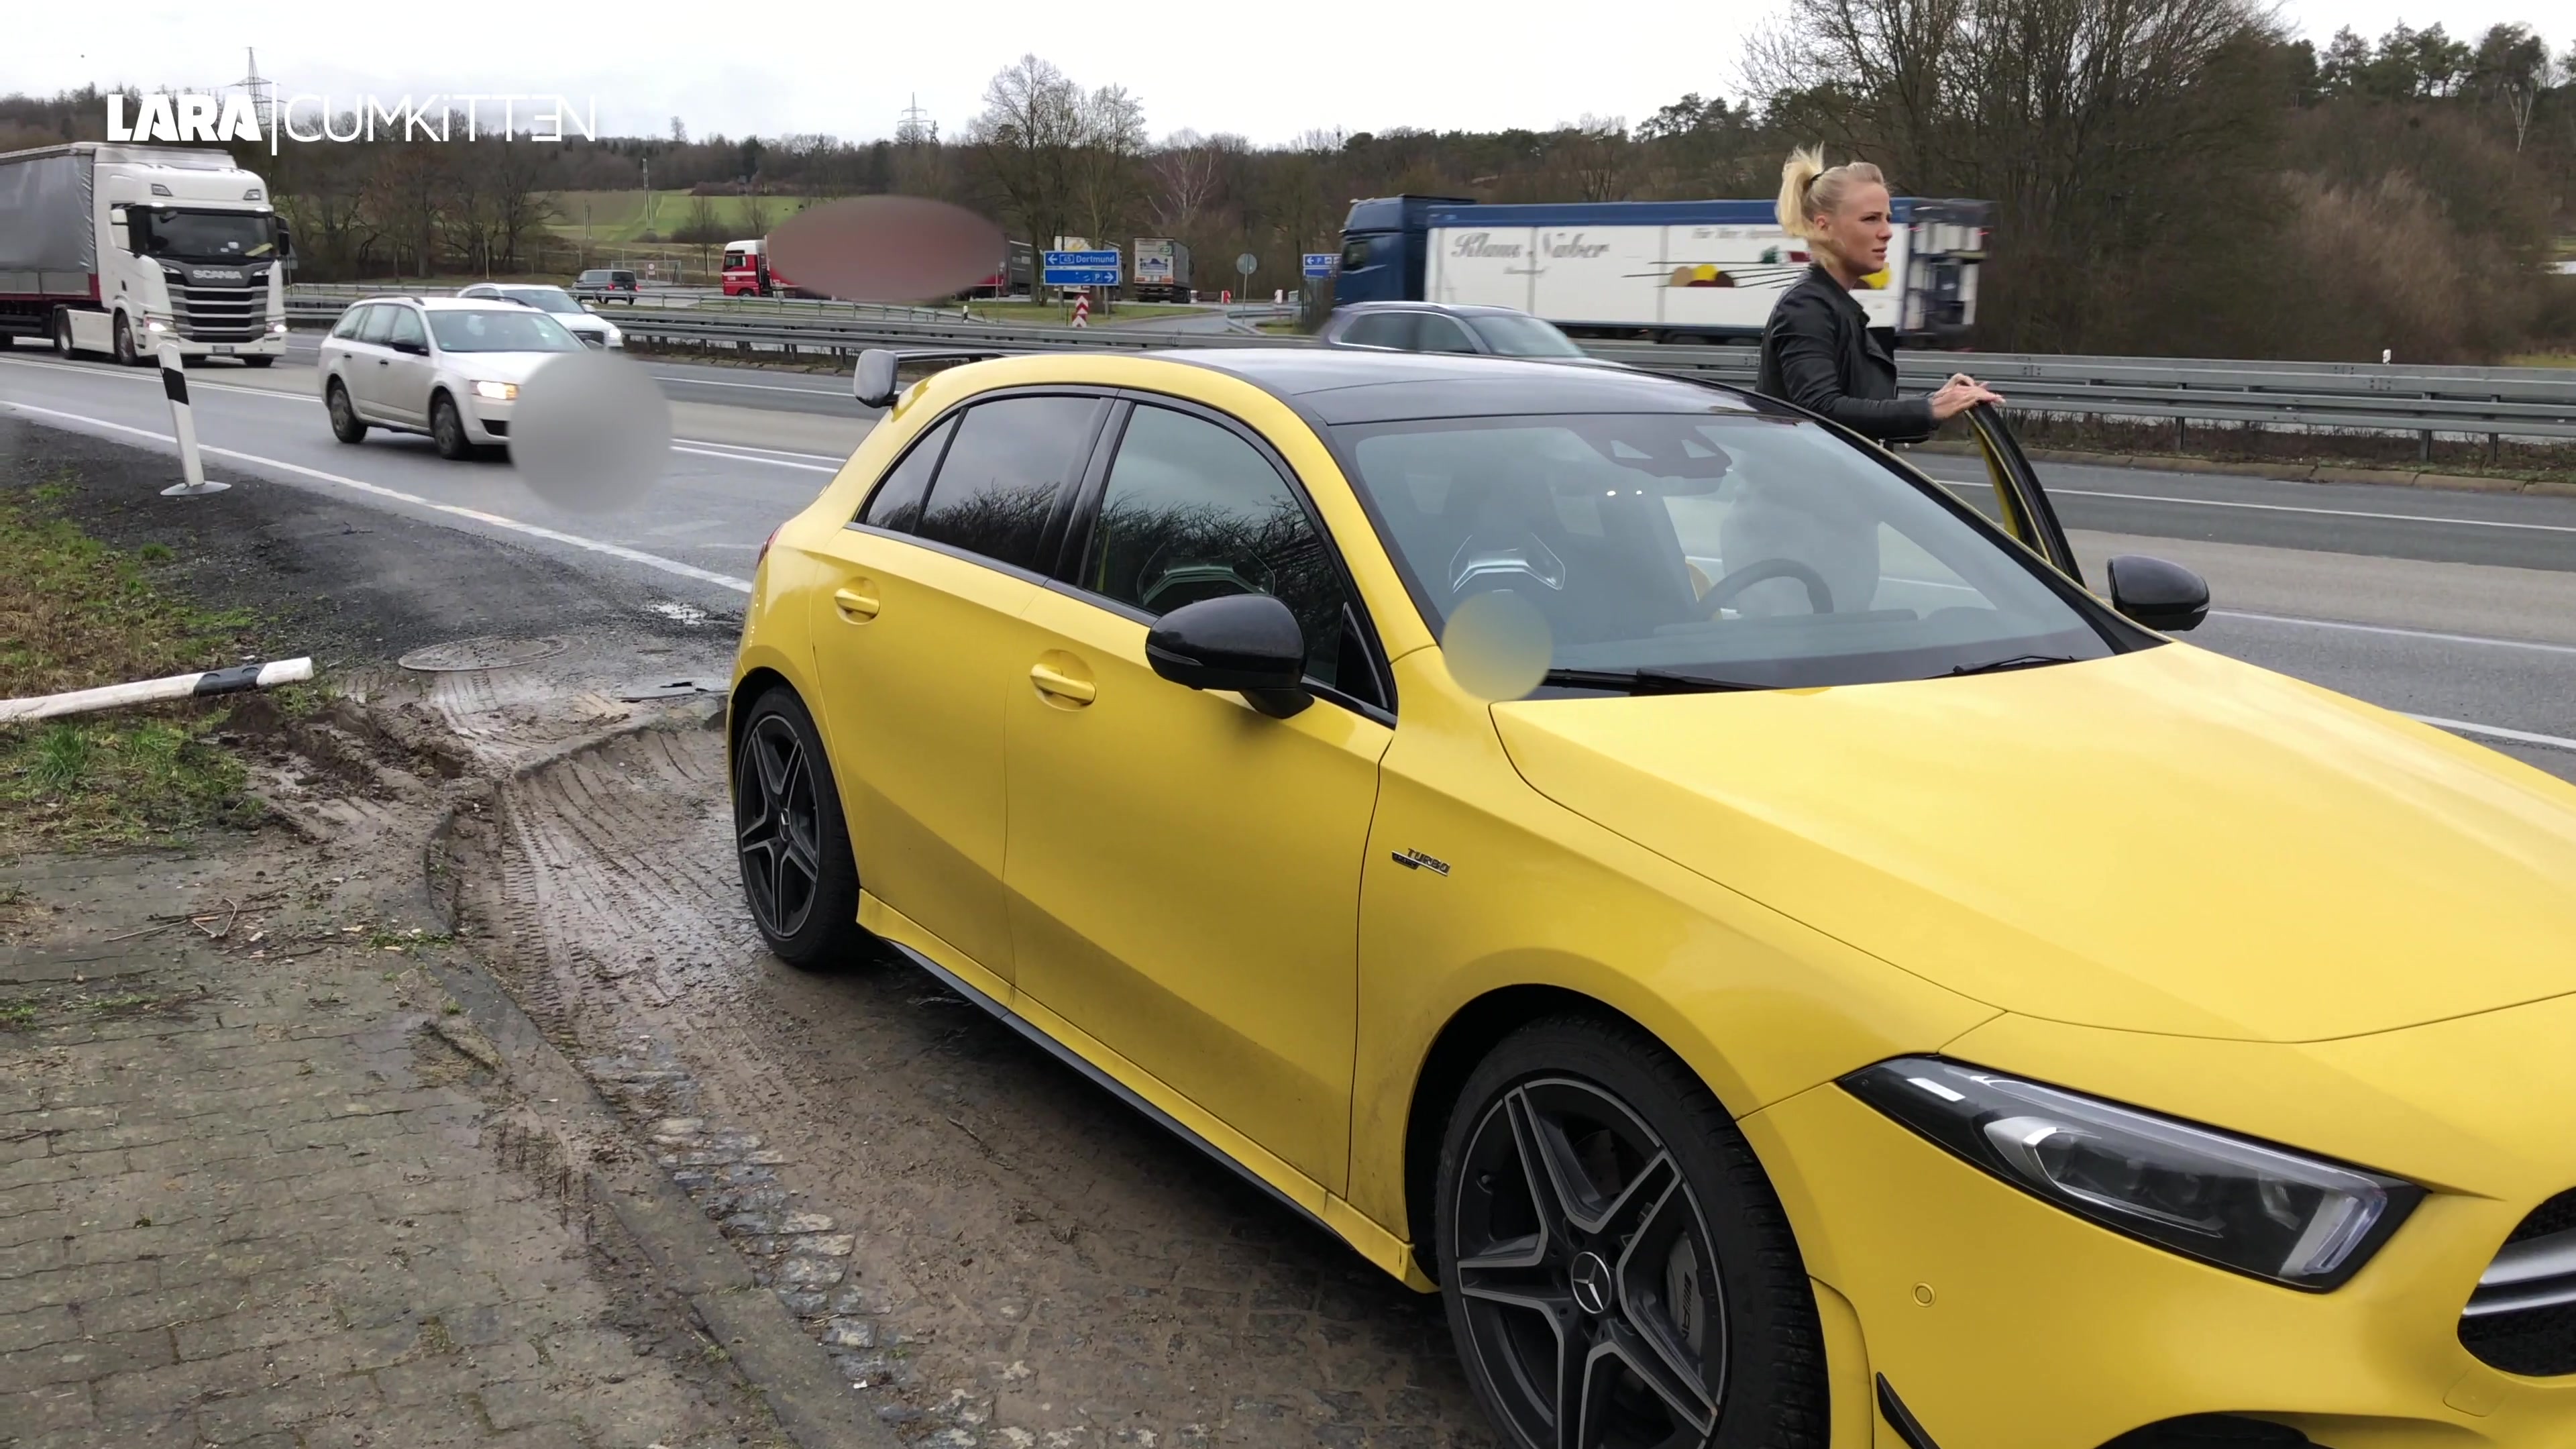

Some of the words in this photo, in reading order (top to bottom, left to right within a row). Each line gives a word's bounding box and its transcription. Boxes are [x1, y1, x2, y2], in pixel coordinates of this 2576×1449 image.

[1076, 255, 1115, 263] Dortmund
[193, 270, 242, 280] SCANIA
[1407, 847, 1450, 873] TURBO
